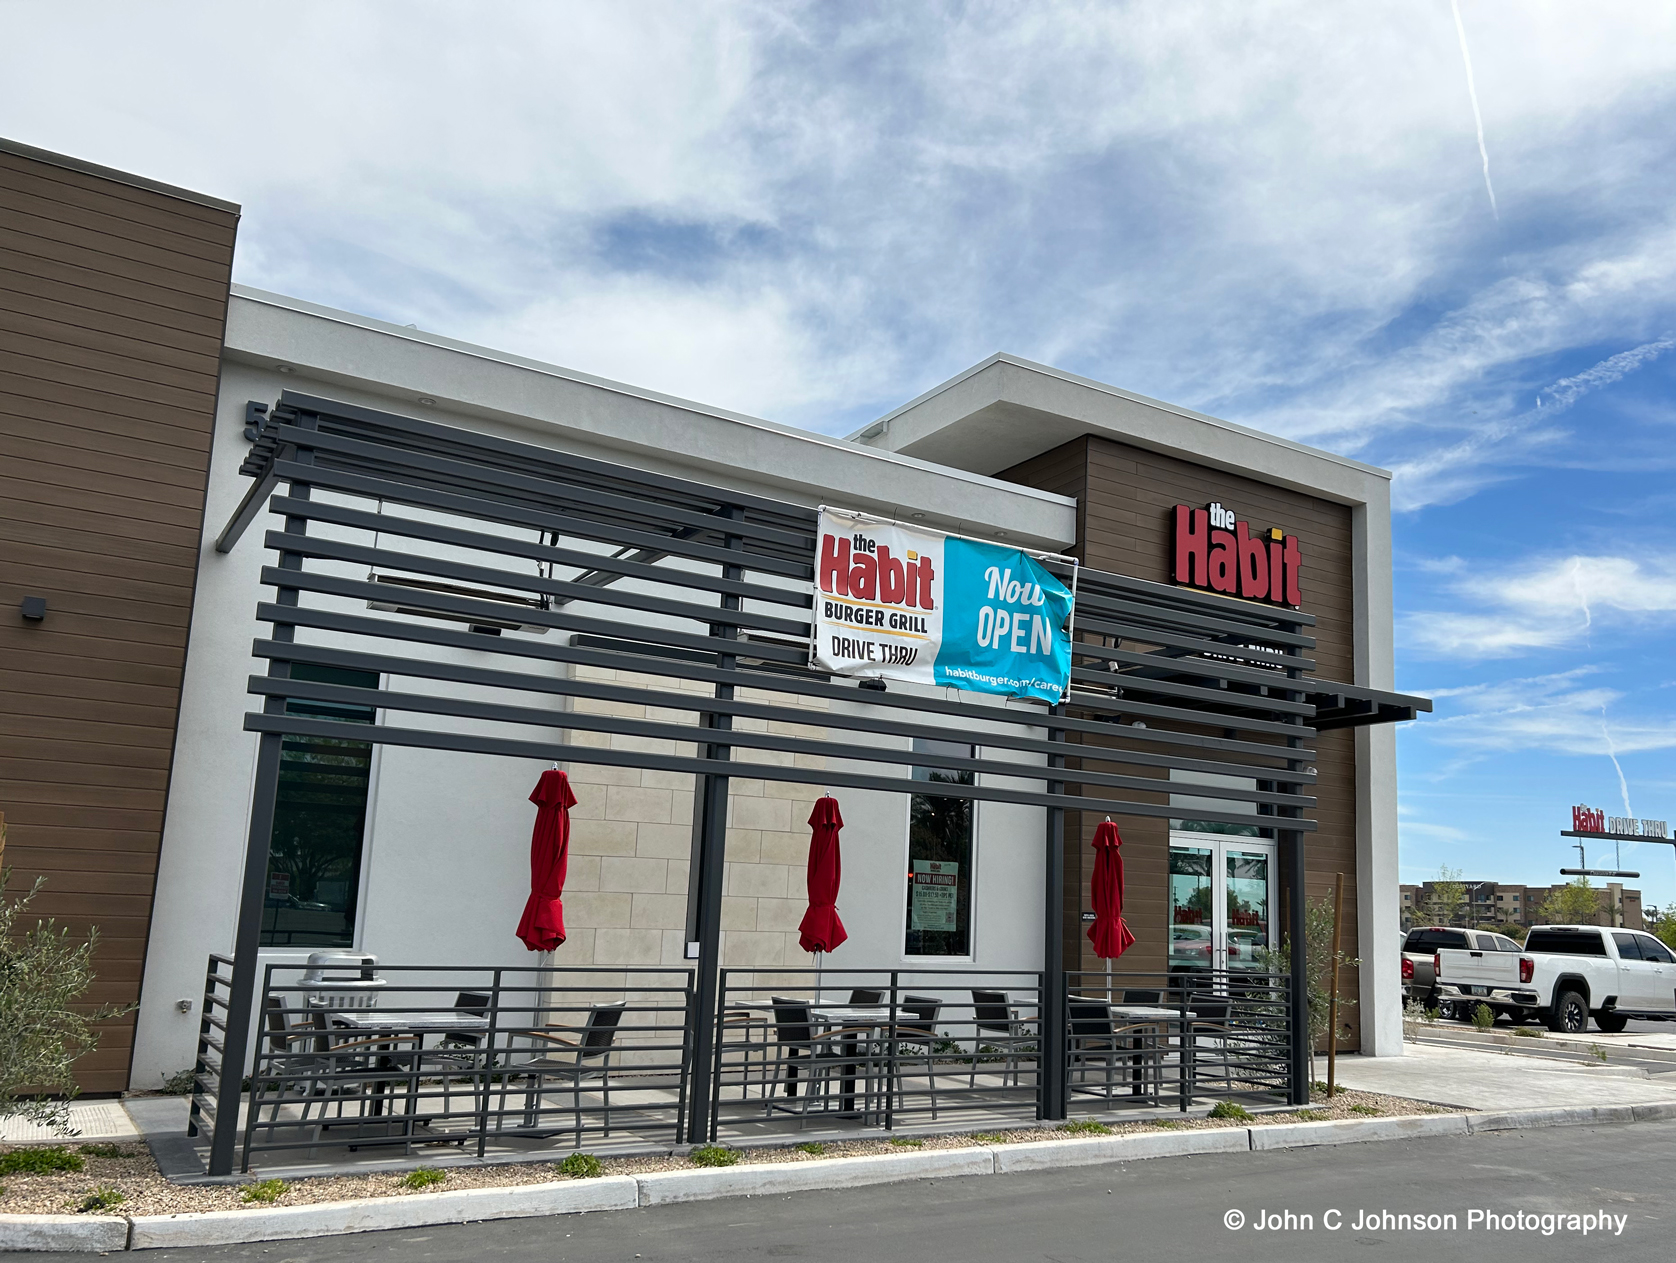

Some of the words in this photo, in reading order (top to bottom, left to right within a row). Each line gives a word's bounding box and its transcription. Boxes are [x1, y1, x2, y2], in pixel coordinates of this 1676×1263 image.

[1210, 502, 1235, 530] the
[853, 533, 876, 553] the
[1174, 504, 1302, 606] Habit
[819, 533, 935, 611] Habit
[984, 566, 1046, 607] Now
[824, 601, 885, 627] BURGER
[888, 612, 928, 634] GRILL
[977, 605, 1052, 656] OPEN
[831, 635, 876, 662] DRIVE
[879, 643, 919, 666] THRU
[1572, 805, 1605, 834] Habit
[1608, 816, 1640, 836] DRIVE
[1641, 819, 1668, 839] THRU
[917, 874, 931, 883] NOW
[932, 875, 954, 885] HIRING!
